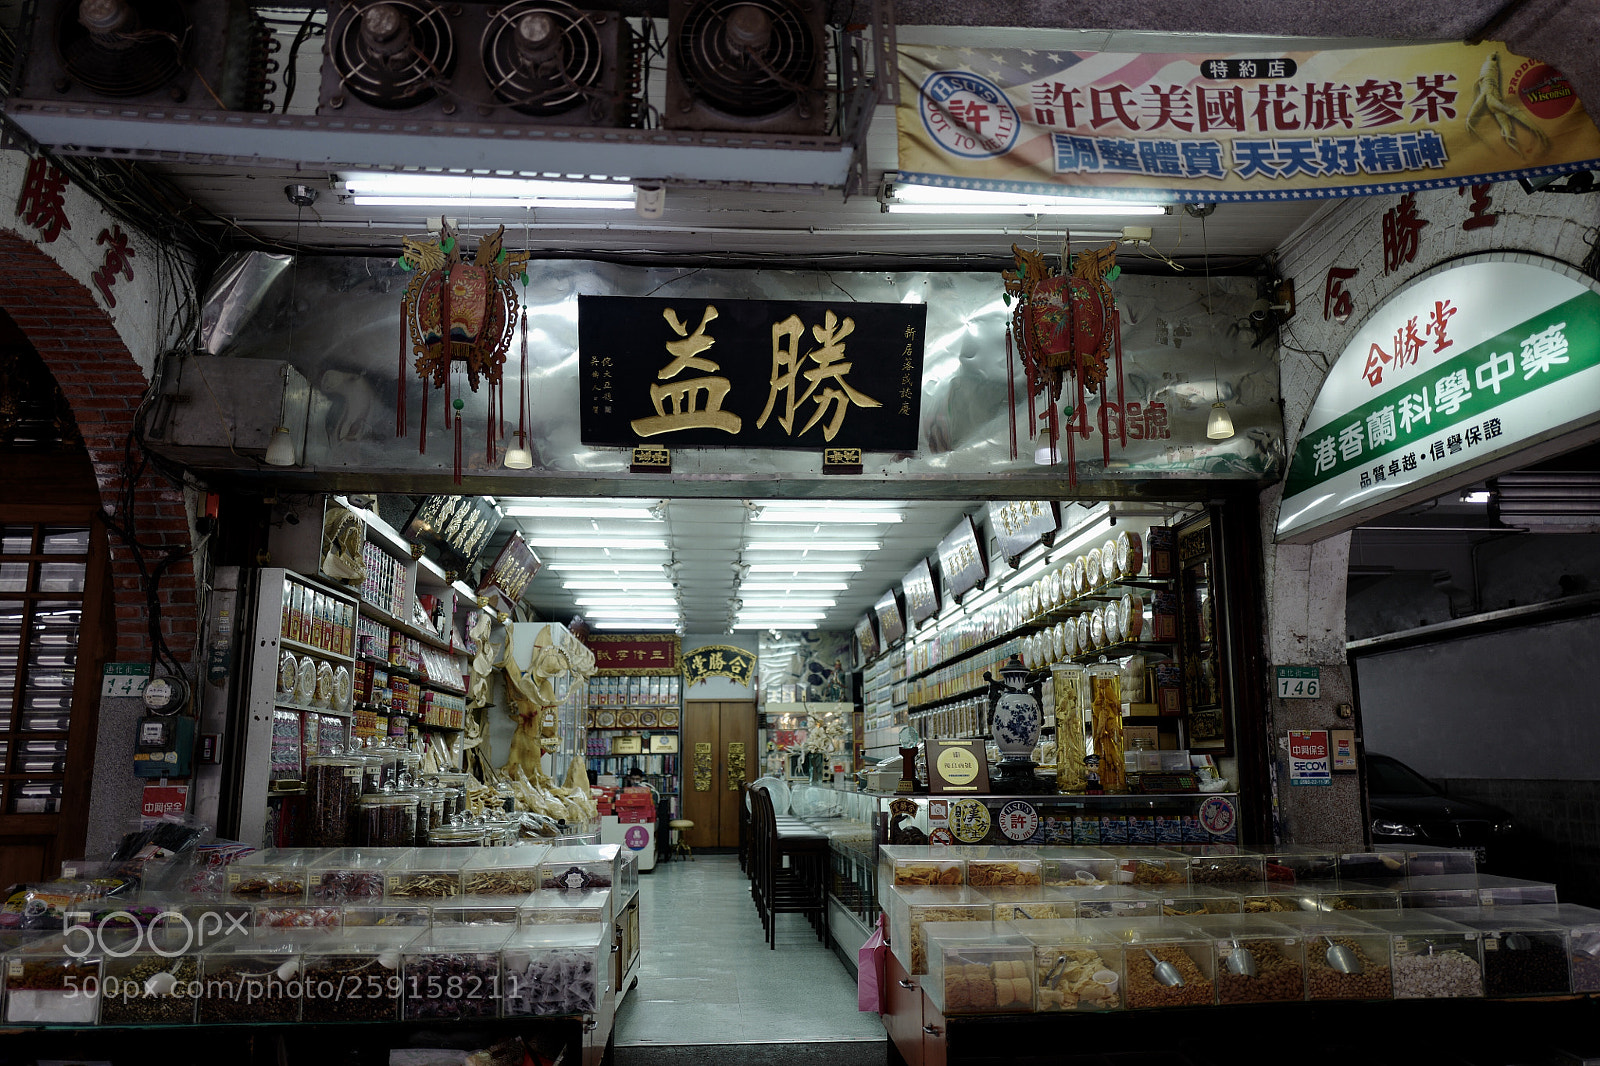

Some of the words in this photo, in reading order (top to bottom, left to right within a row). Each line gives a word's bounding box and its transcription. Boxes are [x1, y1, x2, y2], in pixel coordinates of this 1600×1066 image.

[1210, 60, 1286, 78] 特約店
[932, 78, 996, 104] HSU'S
[1526, 86, 1572, 104] Wisconsin
[1031, 74, 1459, 133] 許氏美國花旗參茶
[948, 100, 990, 135] 許
[954, 133, 976, 150] TO
[1053, 134, 1227, 179] 調整體質
[1232, 130, 1448, 179] 天天好精神
[1361, 299, 1458, 388] 合勝堂
[1312, 321, 1570, 477] 港香蘭科學中藥
[691, 651, 748, 675] 合勝堂
[1282, 680, 1317, 695] 146
[1292, 745, 1325, 756] 中興保全
[1294, 762, 1327, 770] SECOM
[1011, 814, 1027, 829] 許
